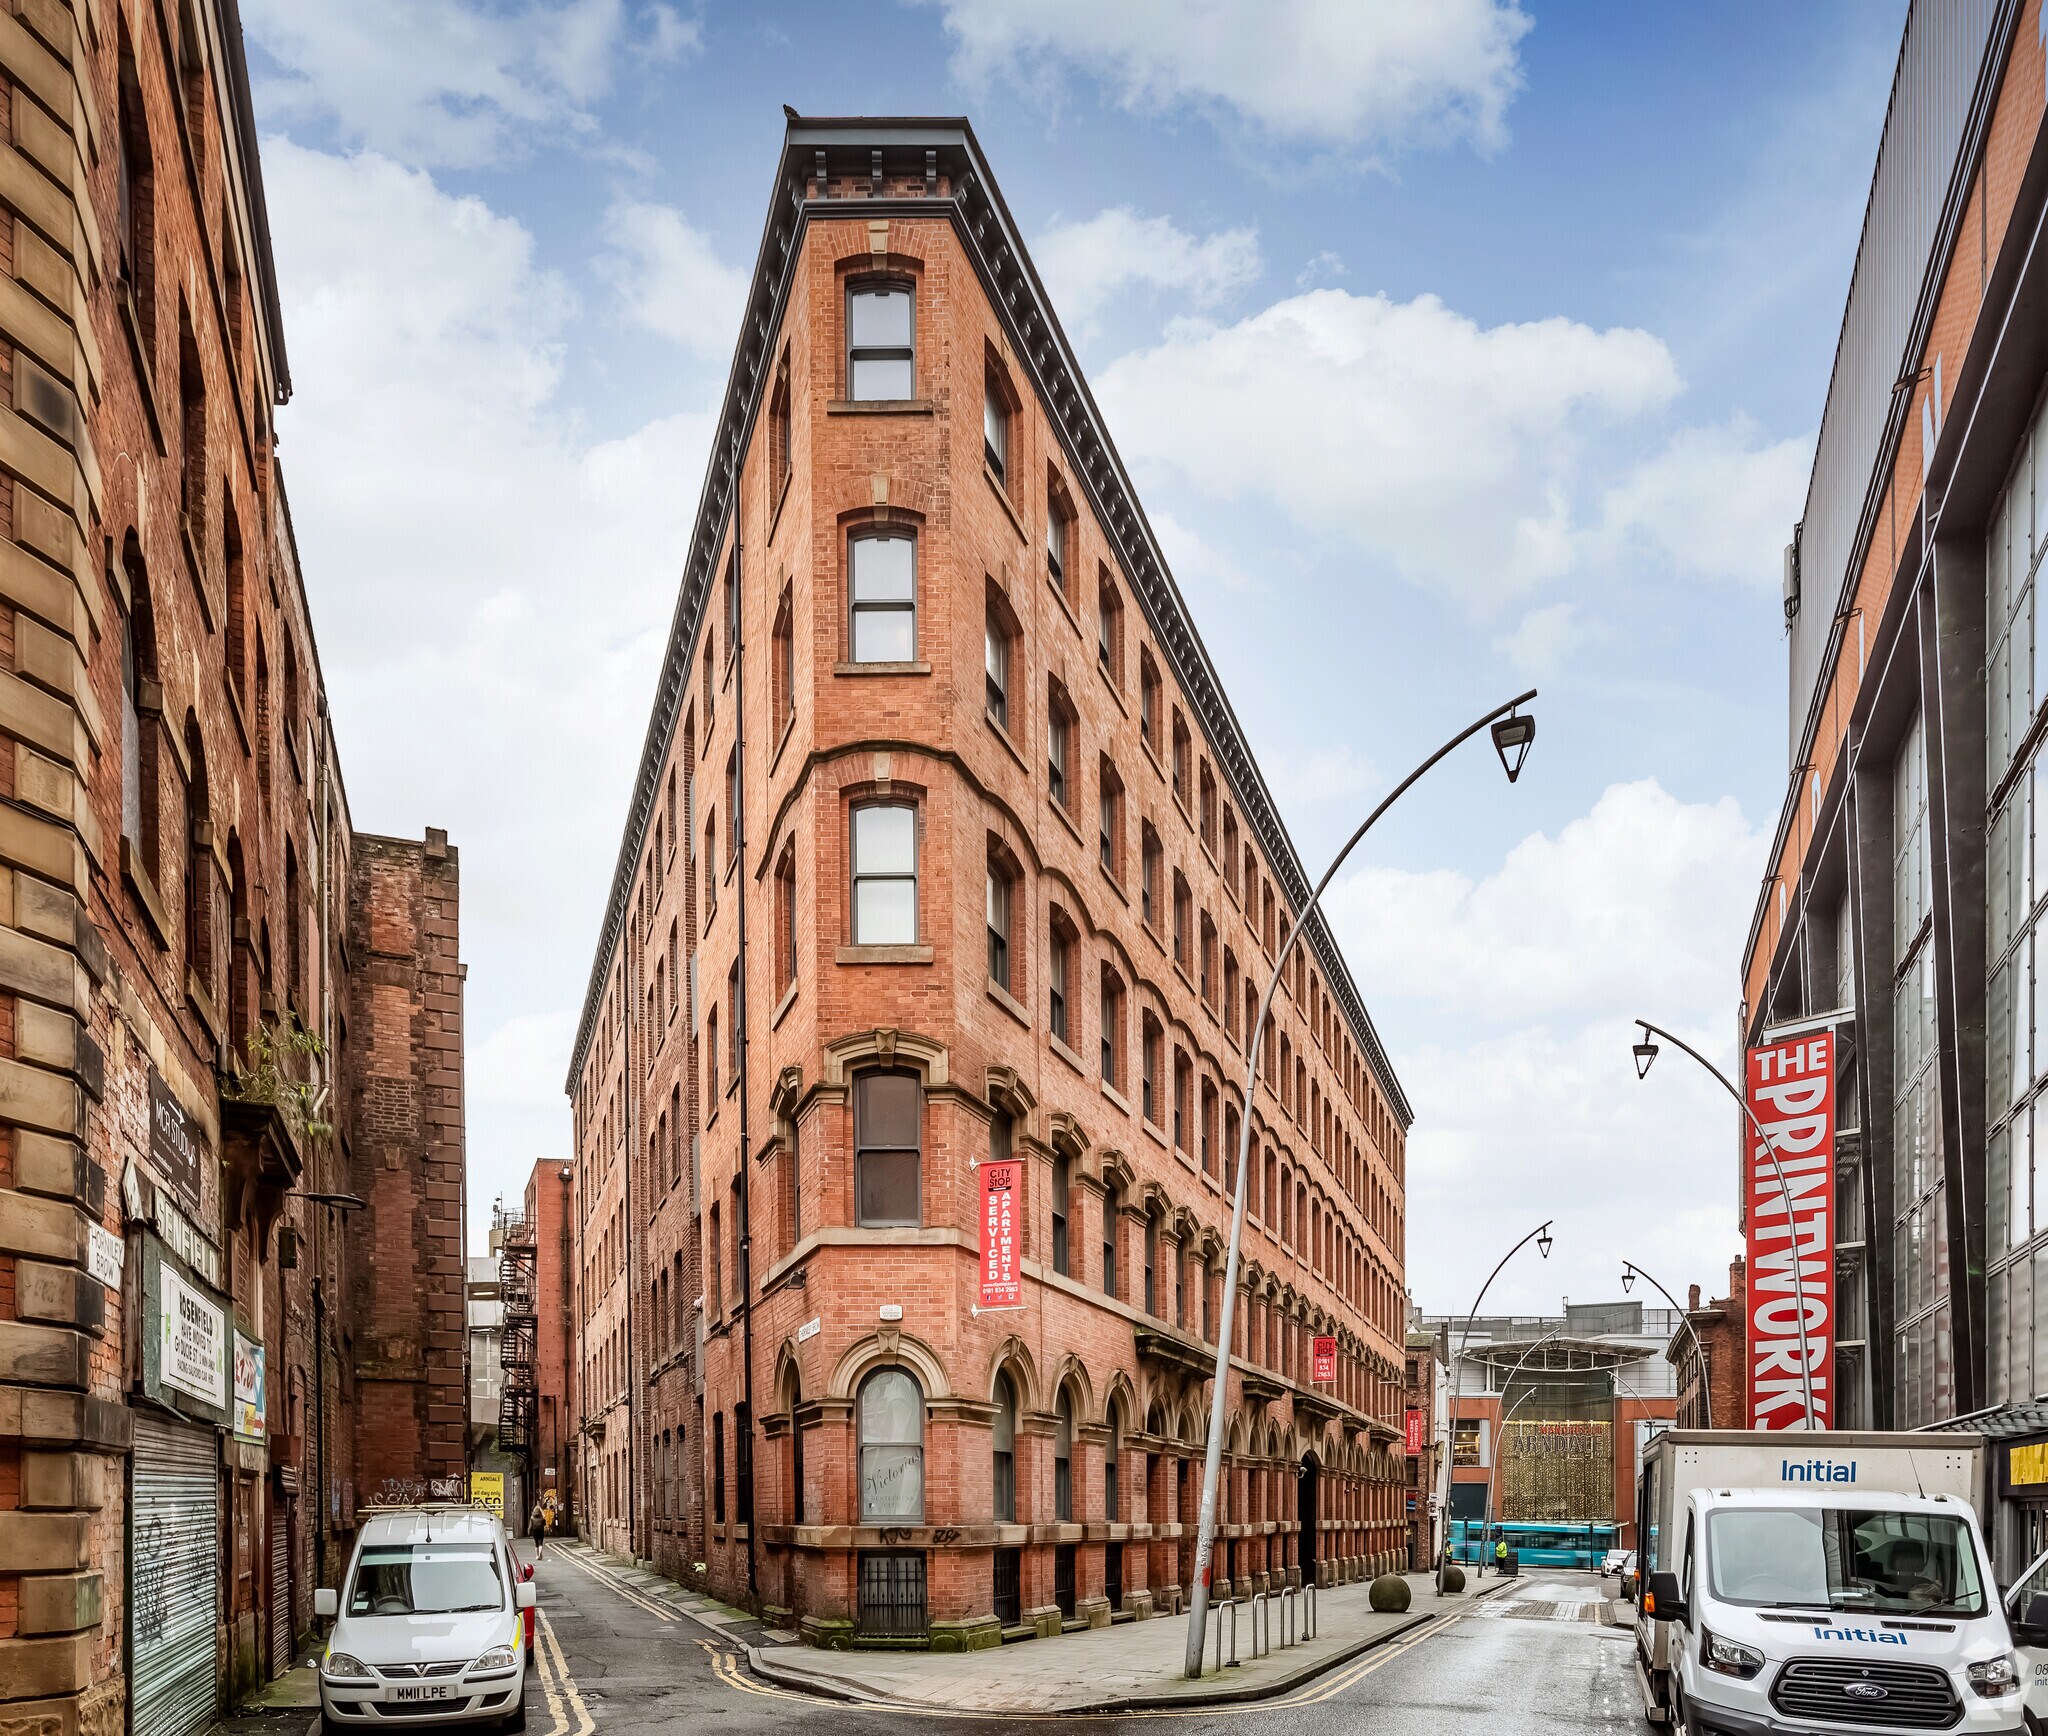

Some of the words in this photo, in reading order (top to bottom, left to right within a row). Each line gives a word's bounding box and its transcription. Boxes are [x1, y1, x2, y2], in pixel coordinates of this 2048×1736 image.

[1755, 1039, 1827, 1081] THE
[155, 1098, 171, 1137] MCR
[987, 1195, 999, 1280] SERVICED
[1000, 1191, 1012, 1281] APARTMENTS
[179, 1290, 213, 1337] ROSENFIELD
[1513, 1435, 1604, 1453] ARNDALE
[1782, 1460, 1857, 1482] Initial
[1814, 1627, 1908, 1645] Initial
[423, 1686, 447, 1699] LPE
[1855, 1686, 1879, 1697] Ford
